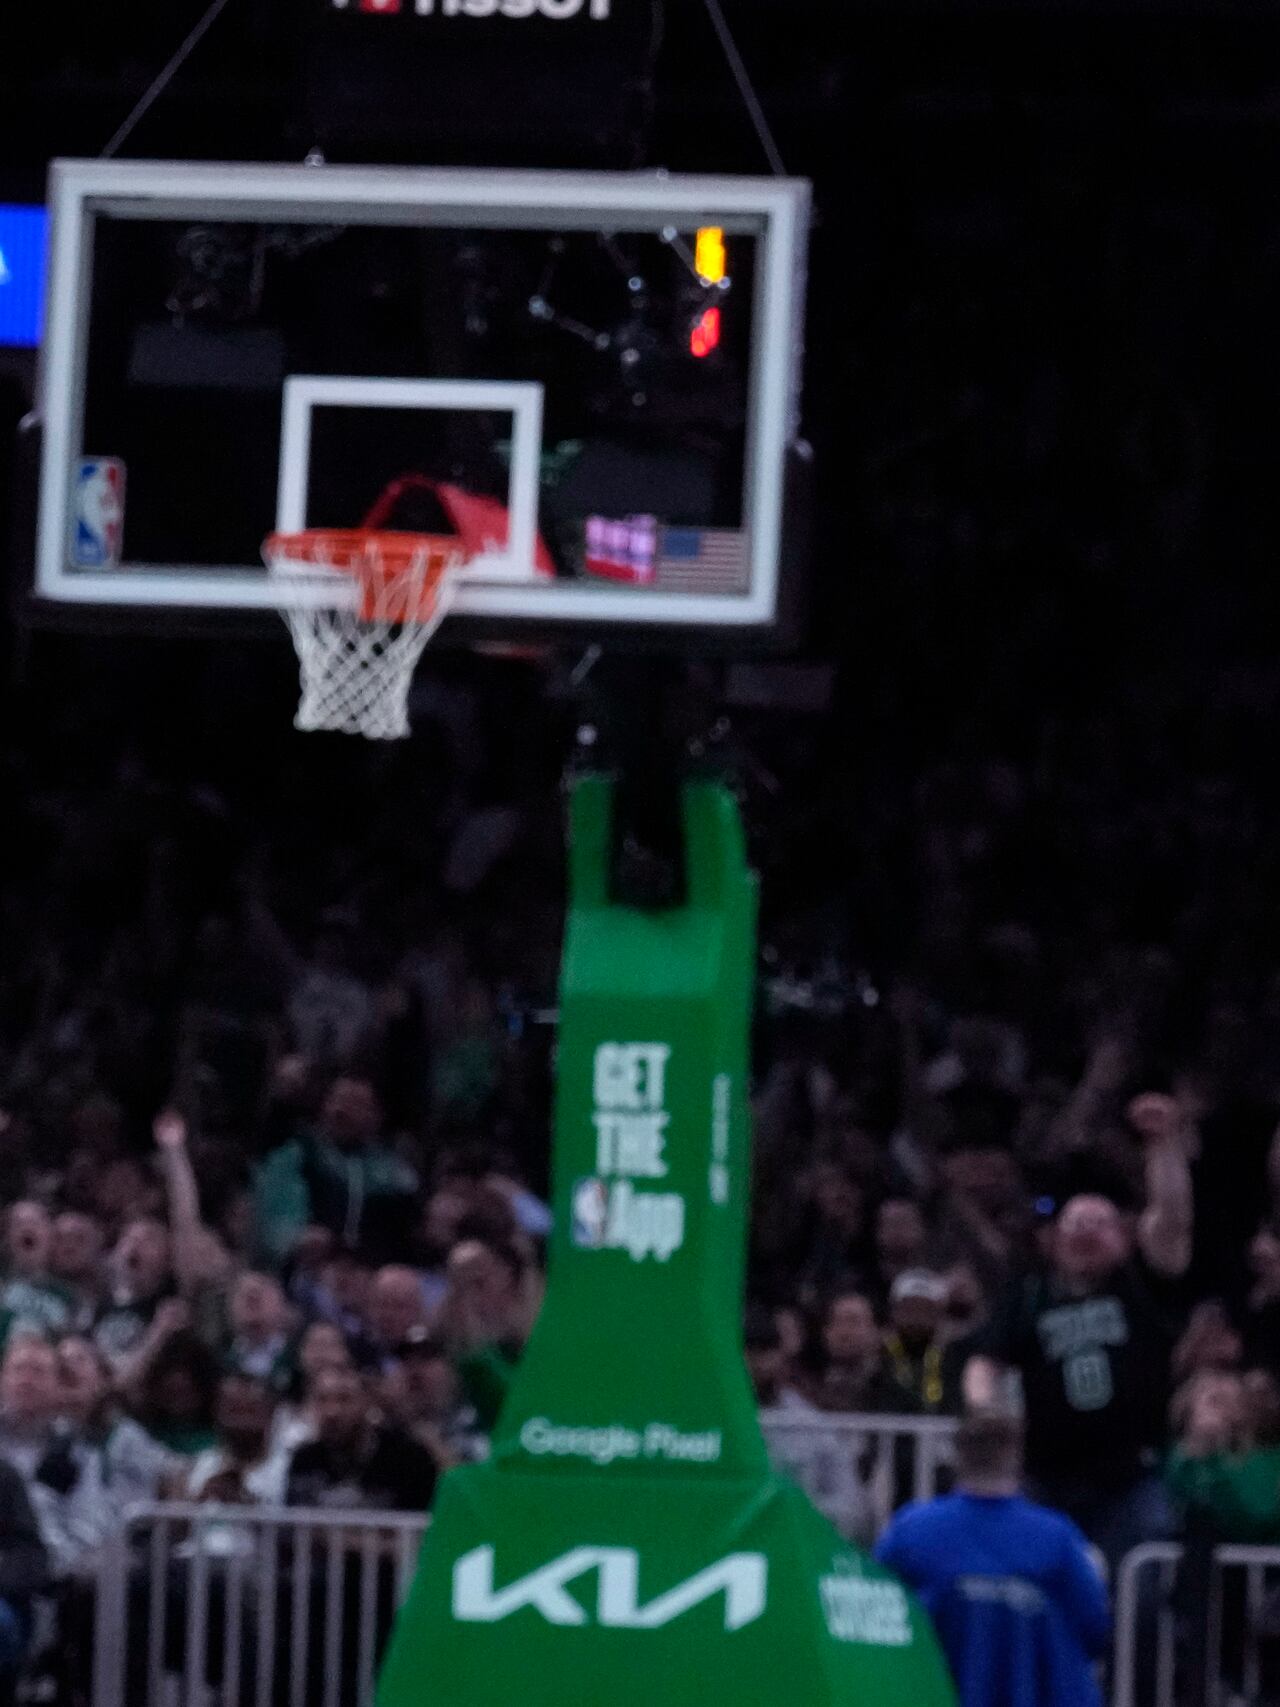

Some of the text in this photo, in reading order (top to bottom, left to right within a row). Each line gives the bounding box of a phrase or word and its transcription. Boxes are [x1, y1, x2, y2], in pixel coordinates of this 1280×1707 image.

[593, 1041, 672, 1109] GET
[591, 1111, 670, 1178] THE
[604, 1178, 685, 1263] App
[519, 1416, 641, 1465] Google
[452, 1544, 768, 1632] KIA
